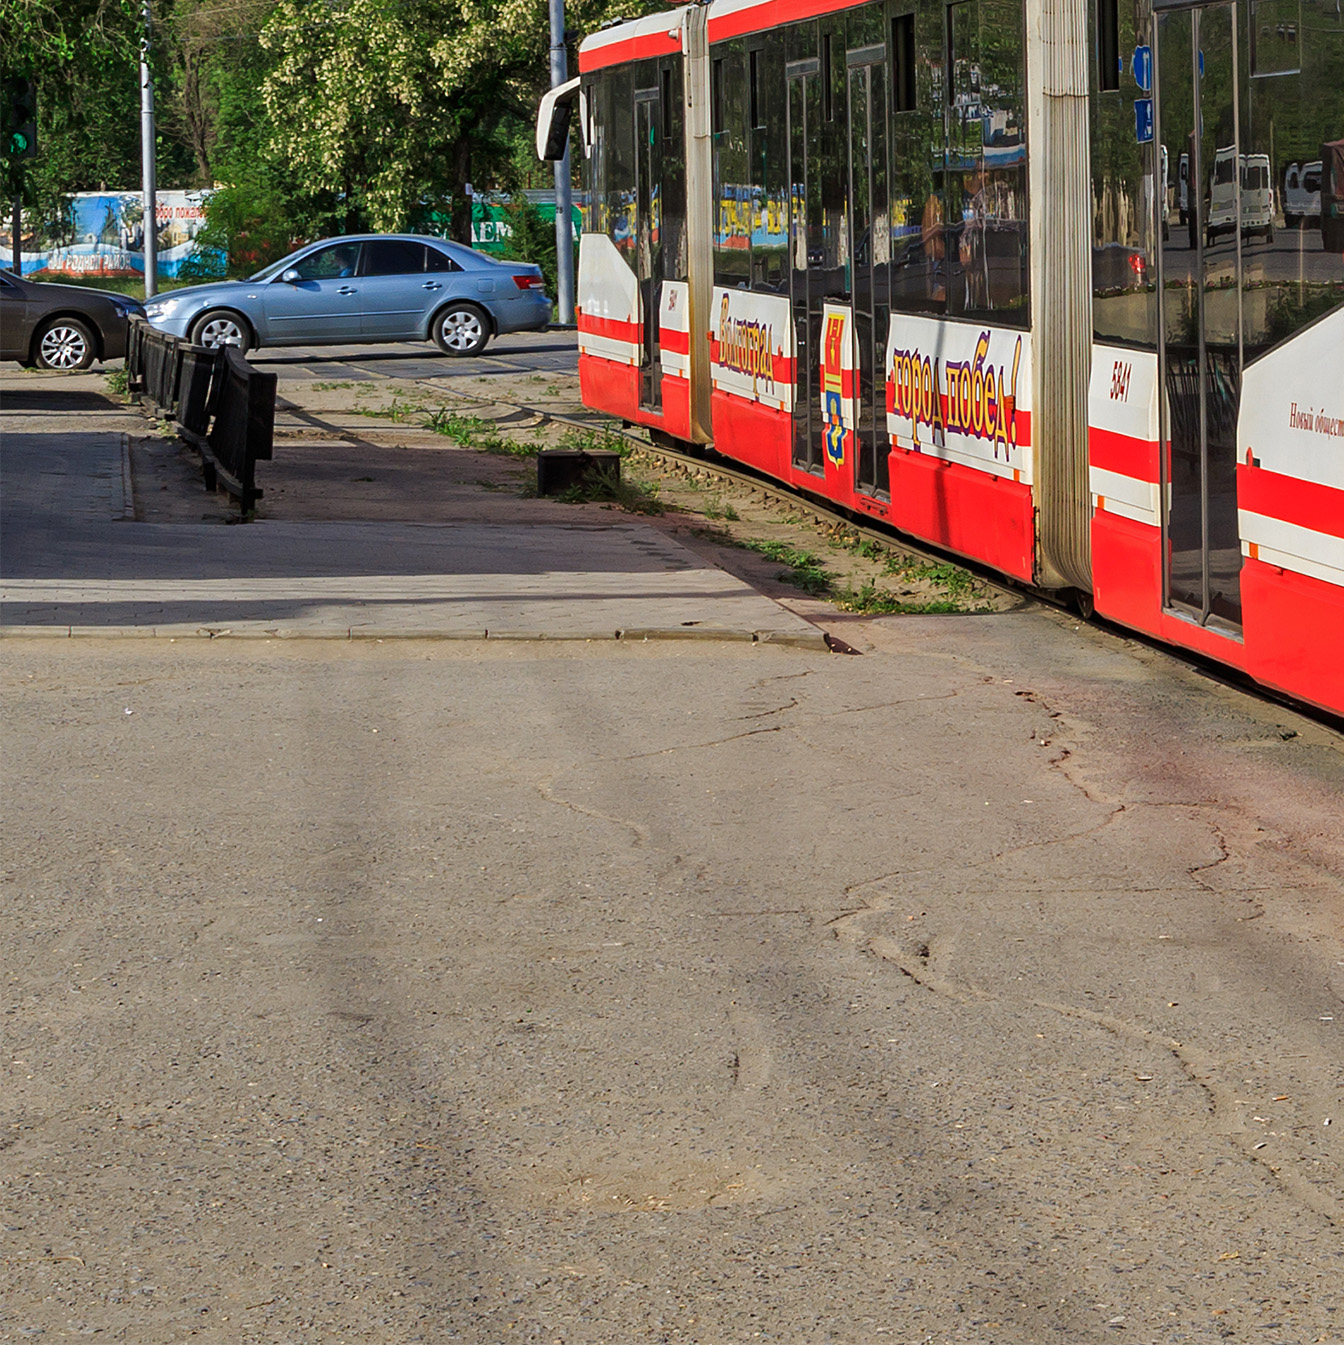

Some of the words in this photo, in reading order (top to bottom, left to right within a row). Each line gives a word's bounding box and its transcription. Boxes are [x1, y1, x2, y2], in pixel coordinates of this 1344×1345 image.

[65, 251, 101, 274] РОДНОЙ
[103, 250, 131, 270] РАЙОН
[893, 348, 946, 453] город
[946, 330, 1022, 463] побед!
[1110, 361, 1132, 403] 5841
[1289, 402, 1314, 432] Новый
